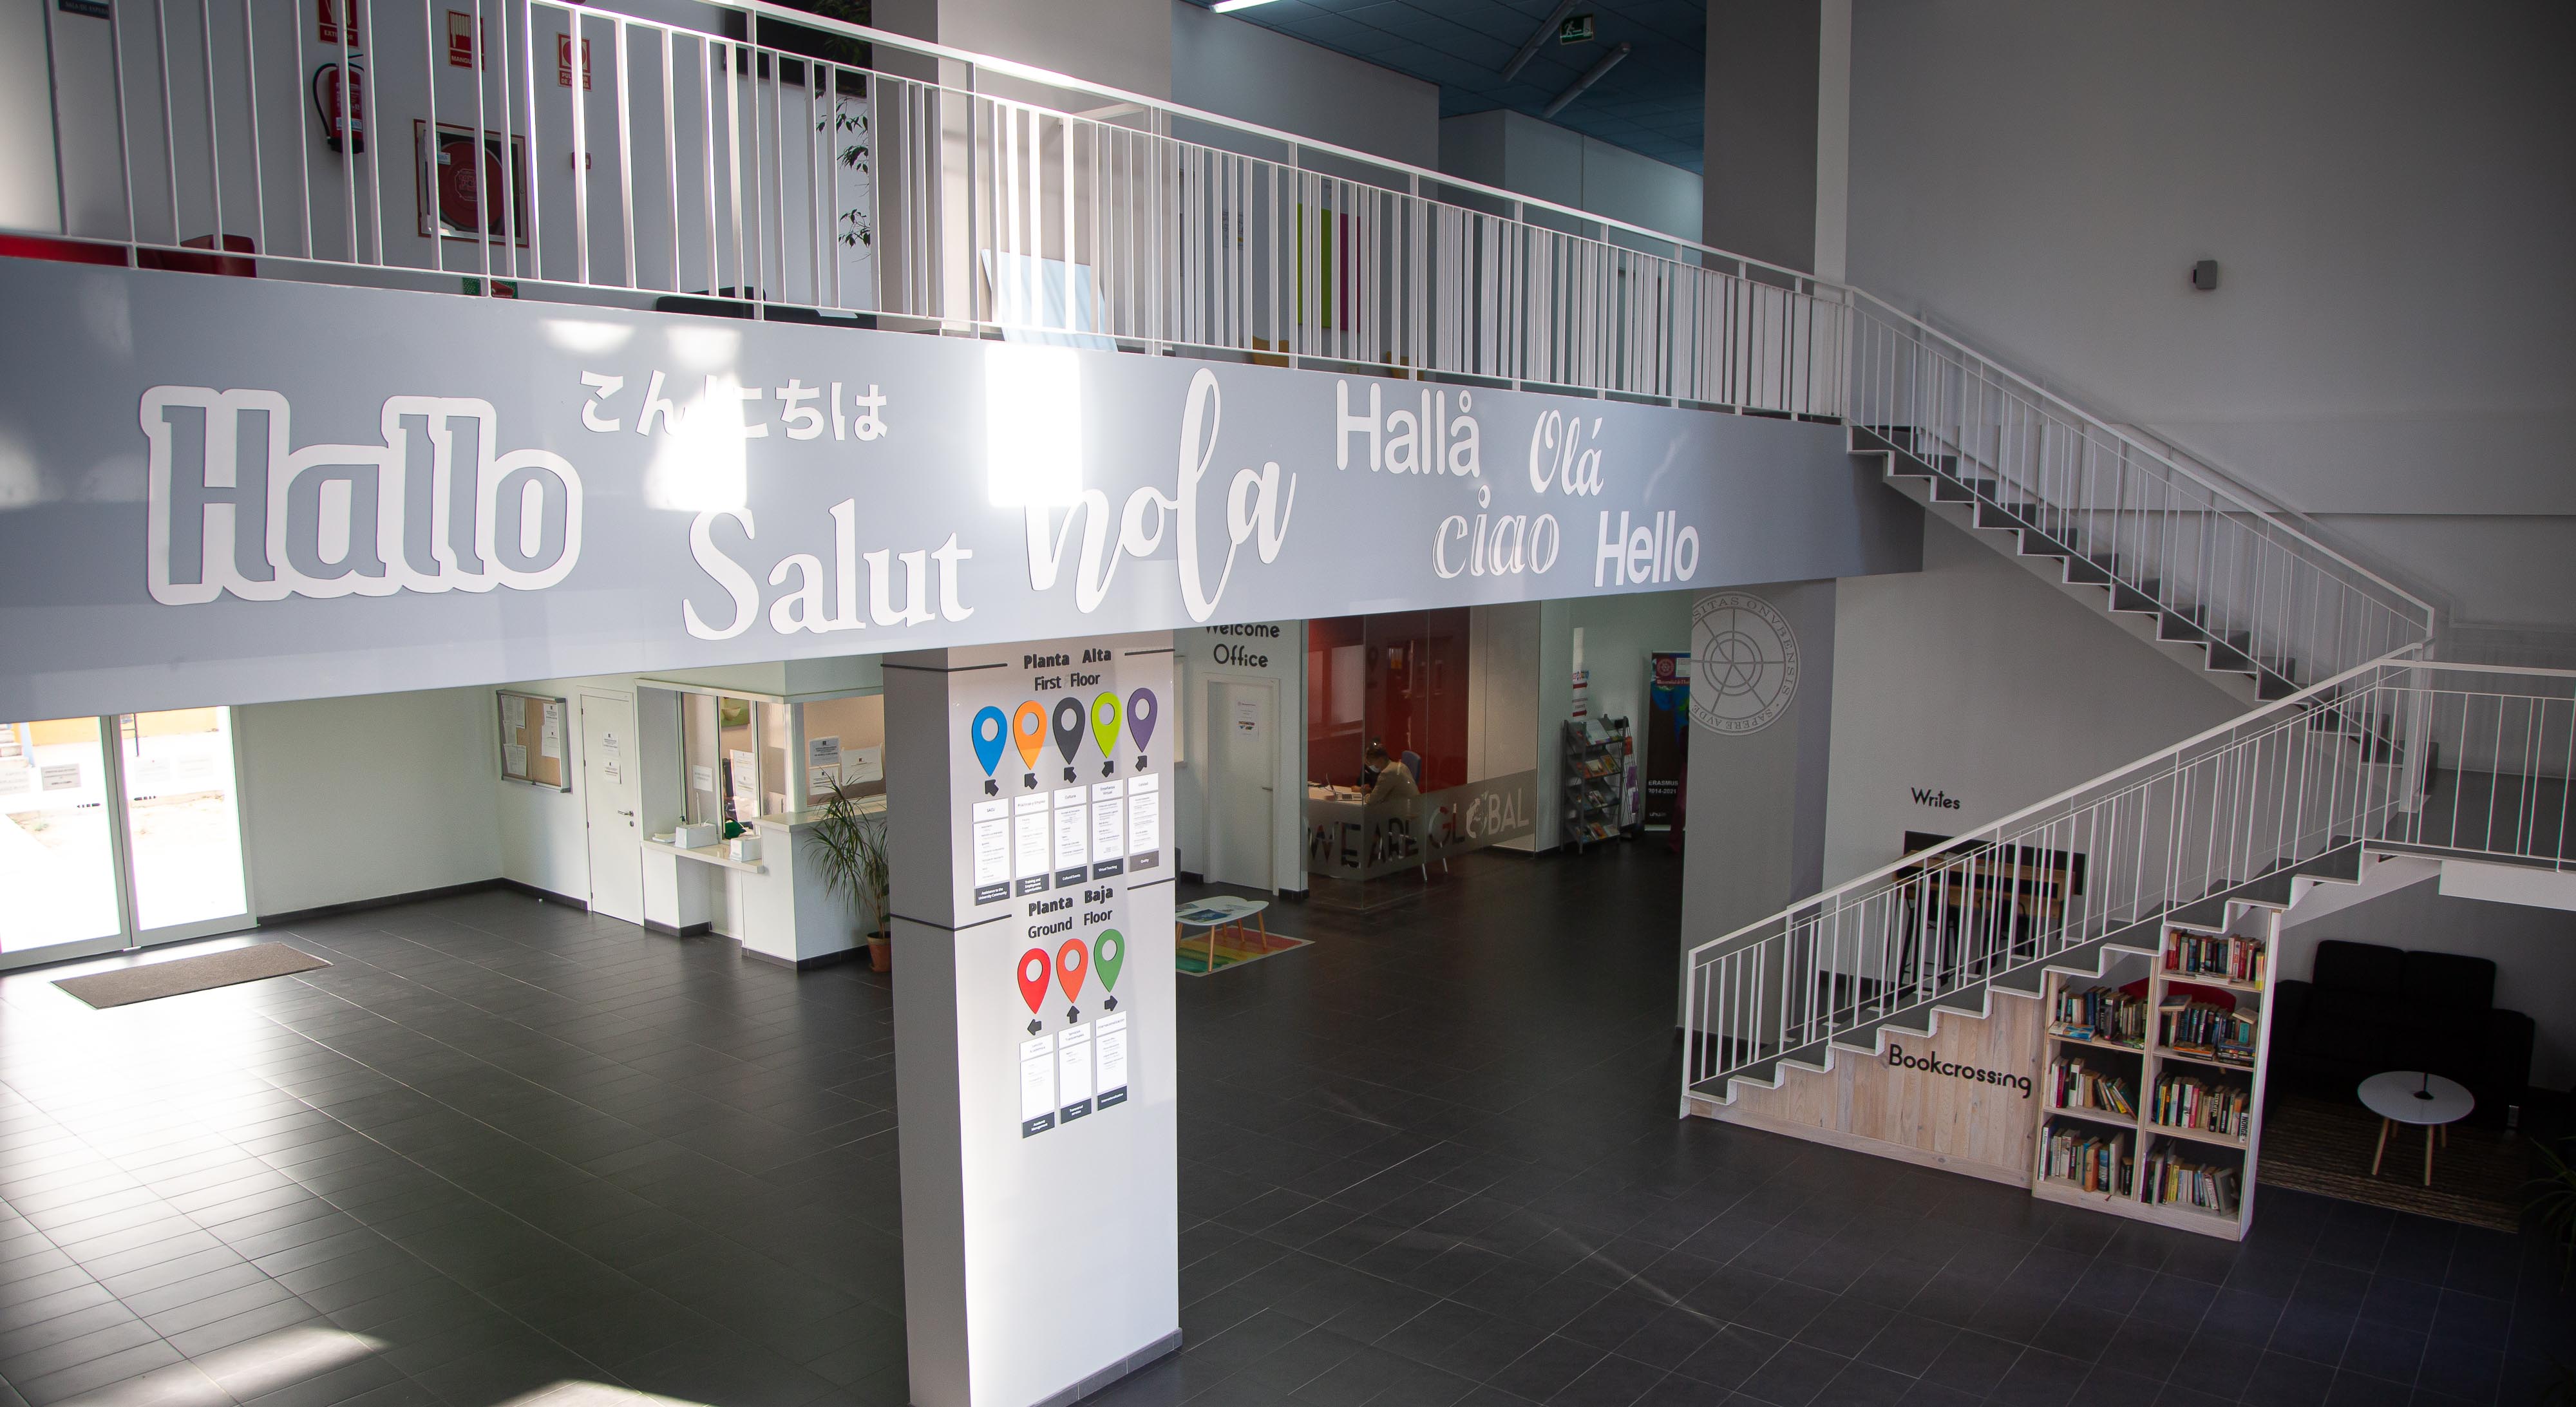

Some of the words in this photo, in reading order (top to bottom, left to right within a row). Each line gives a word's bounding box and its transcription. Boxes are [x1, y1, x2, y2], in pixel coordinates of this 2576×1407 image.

[325, 30, 354, 40] EXTIOR
[1336, 379, 1481, 478] Hallå
[1529, 410, 1605, 496] Olá
[140, 385, 583, 606] Hallo
[1432, 485, 1560, 580] ciao
[1594, 510, 1700, 588] Hello
[682, 498, 974, 641] Salut
[1024, 653, 1070, 669] Planta
[1082, 648, 1112, 663] Alta
[1213, 643, 1268, 668] Office
[1034, 676, 1061, 691] First
[1070, 672, 1101, 687] Floor
[1911, 787, 1960, 809] Writes
[1028, 897, 1073, 917] Planta
[1084, 885, 1113, 904] Baja
[1028, 916, 1072, 939] Ground
[1084, 910, 1113, 926] Floor
[1889, 1043, 2032, 1099] Bookcrossing
[2240, 1115, 2249, 1137] NORGE
